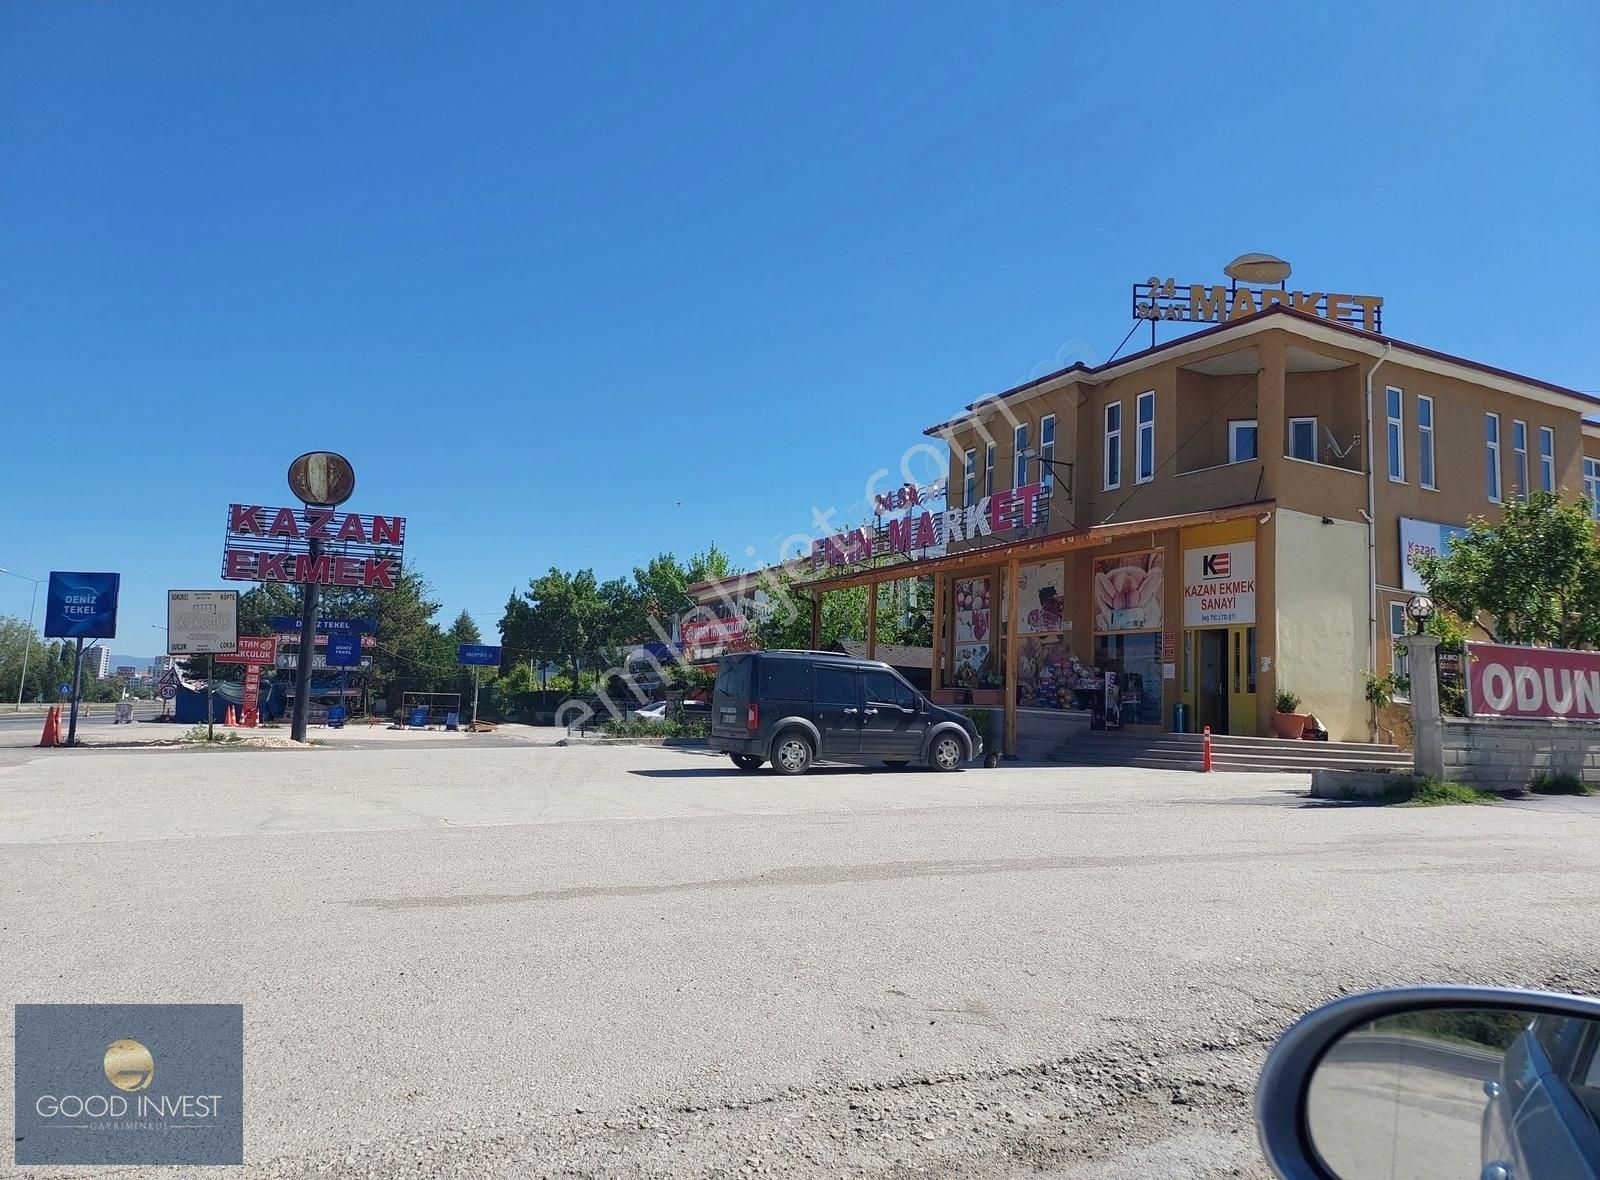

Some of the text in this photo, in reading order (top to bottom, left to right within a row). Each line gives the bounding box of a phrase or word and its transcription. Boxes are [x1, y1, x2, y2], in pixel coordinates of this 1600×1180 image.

[1147, 277, 1176, 299] 24
[1137, 302, 1186, 321] SAAT
[230, 503, 401, 545] KAZAN
[889, 483, 1043, 555] MARKET
[1407, 541, 1437, 555] Kazan
[226, 549, 397, 589] EKMEK
[1185, 580, 1255, 598] KAZAN EKMEK
[65, 593, 97, 604] DENİZ
[1201, 594, 1237, 611] SANAYİ
[64, 605, 97, 614] TEKEL
[324, 621, 350, 629] TEKEL
[163, 688, 175, 696] 50
[1482, 663, 1600, 714] ODUN
